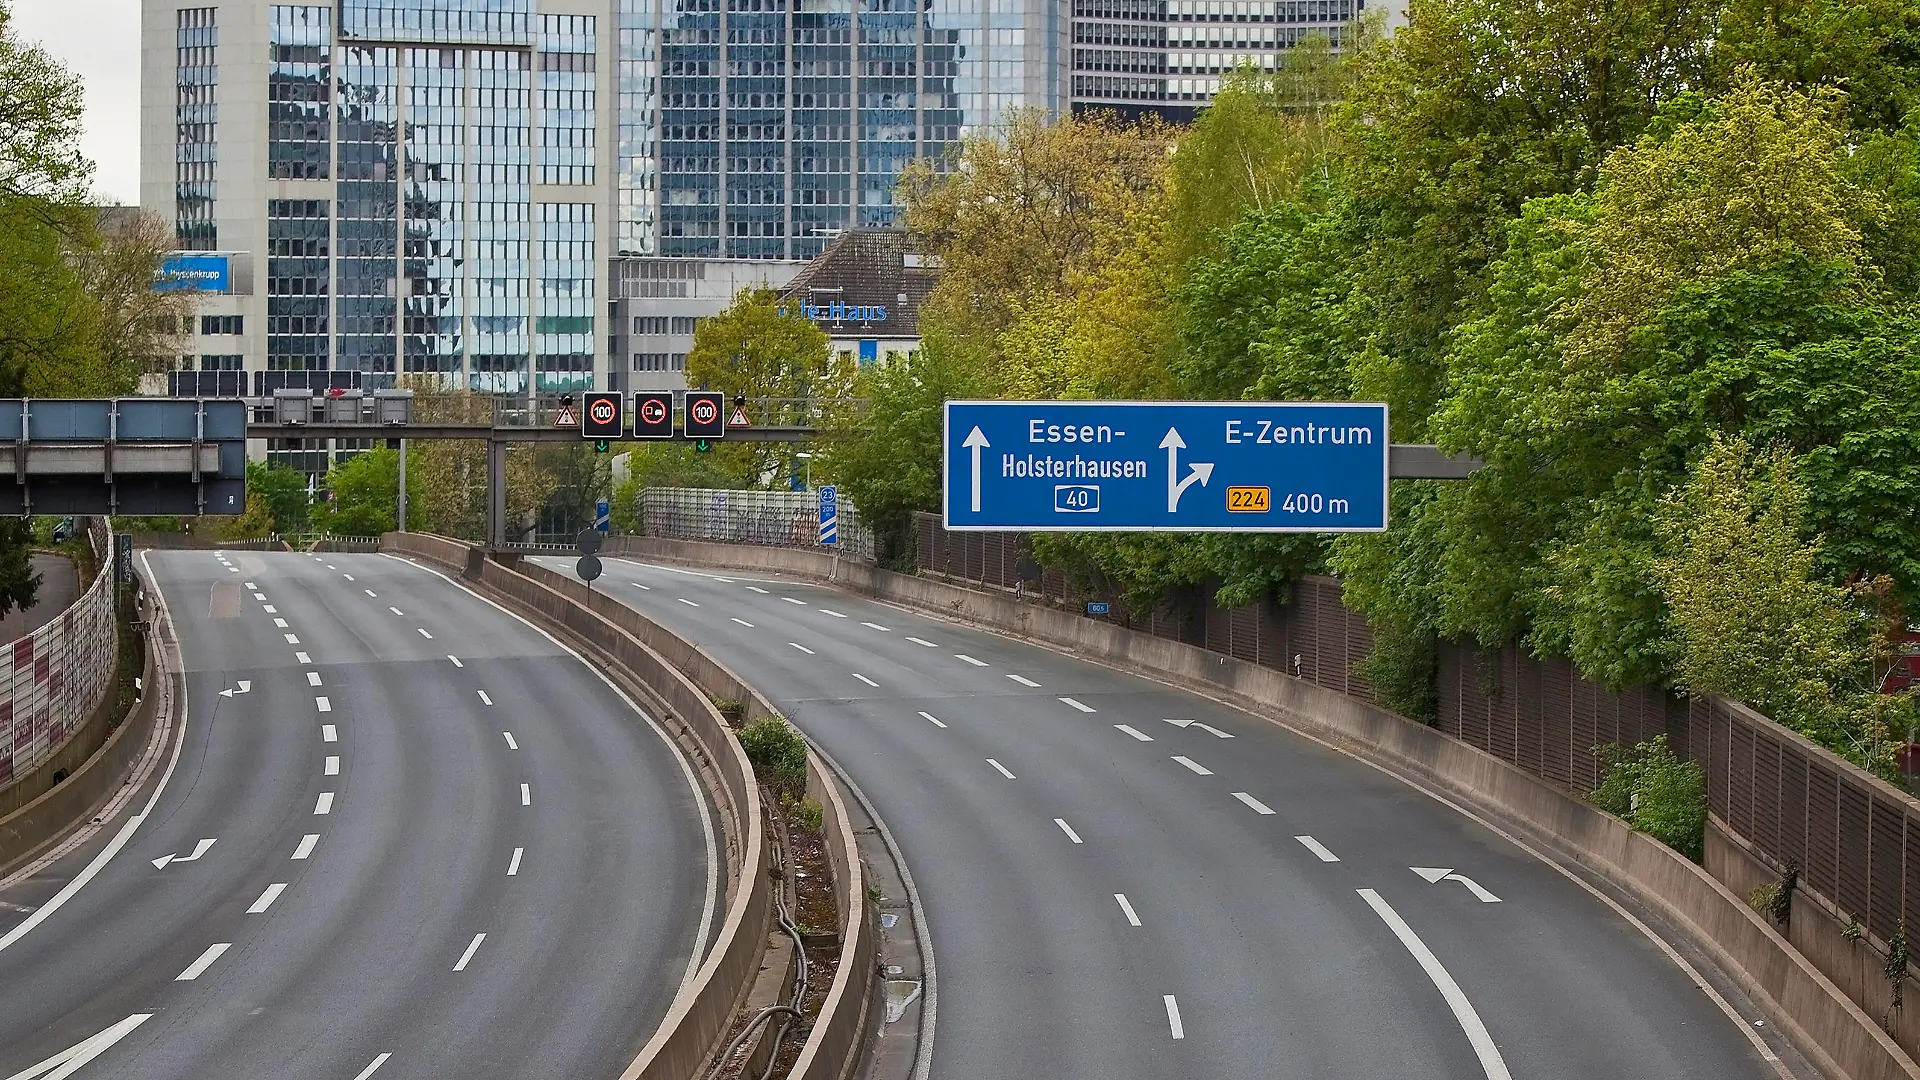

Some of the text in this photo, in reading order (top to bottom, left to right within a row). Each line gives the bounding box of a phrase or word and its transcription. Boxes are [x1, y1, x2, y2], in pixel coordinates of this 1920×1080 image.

[829, 300, 888, 320] Haus
[594, 406, 612, 418] 100
[696, 406, 713, 418] 100
[1029, 419, 1126, 443] Essen-
[1226, 420, 1372, 444] E-Zentrum
[1002, 454, 1147, 478] Holsterhausen
[822, 491, 833, 499] 23
[1066, 490, 1088, 507] 40
[1231, 491, 1265, 508] 224
[1282, 493, 1349, 514] 400 m
